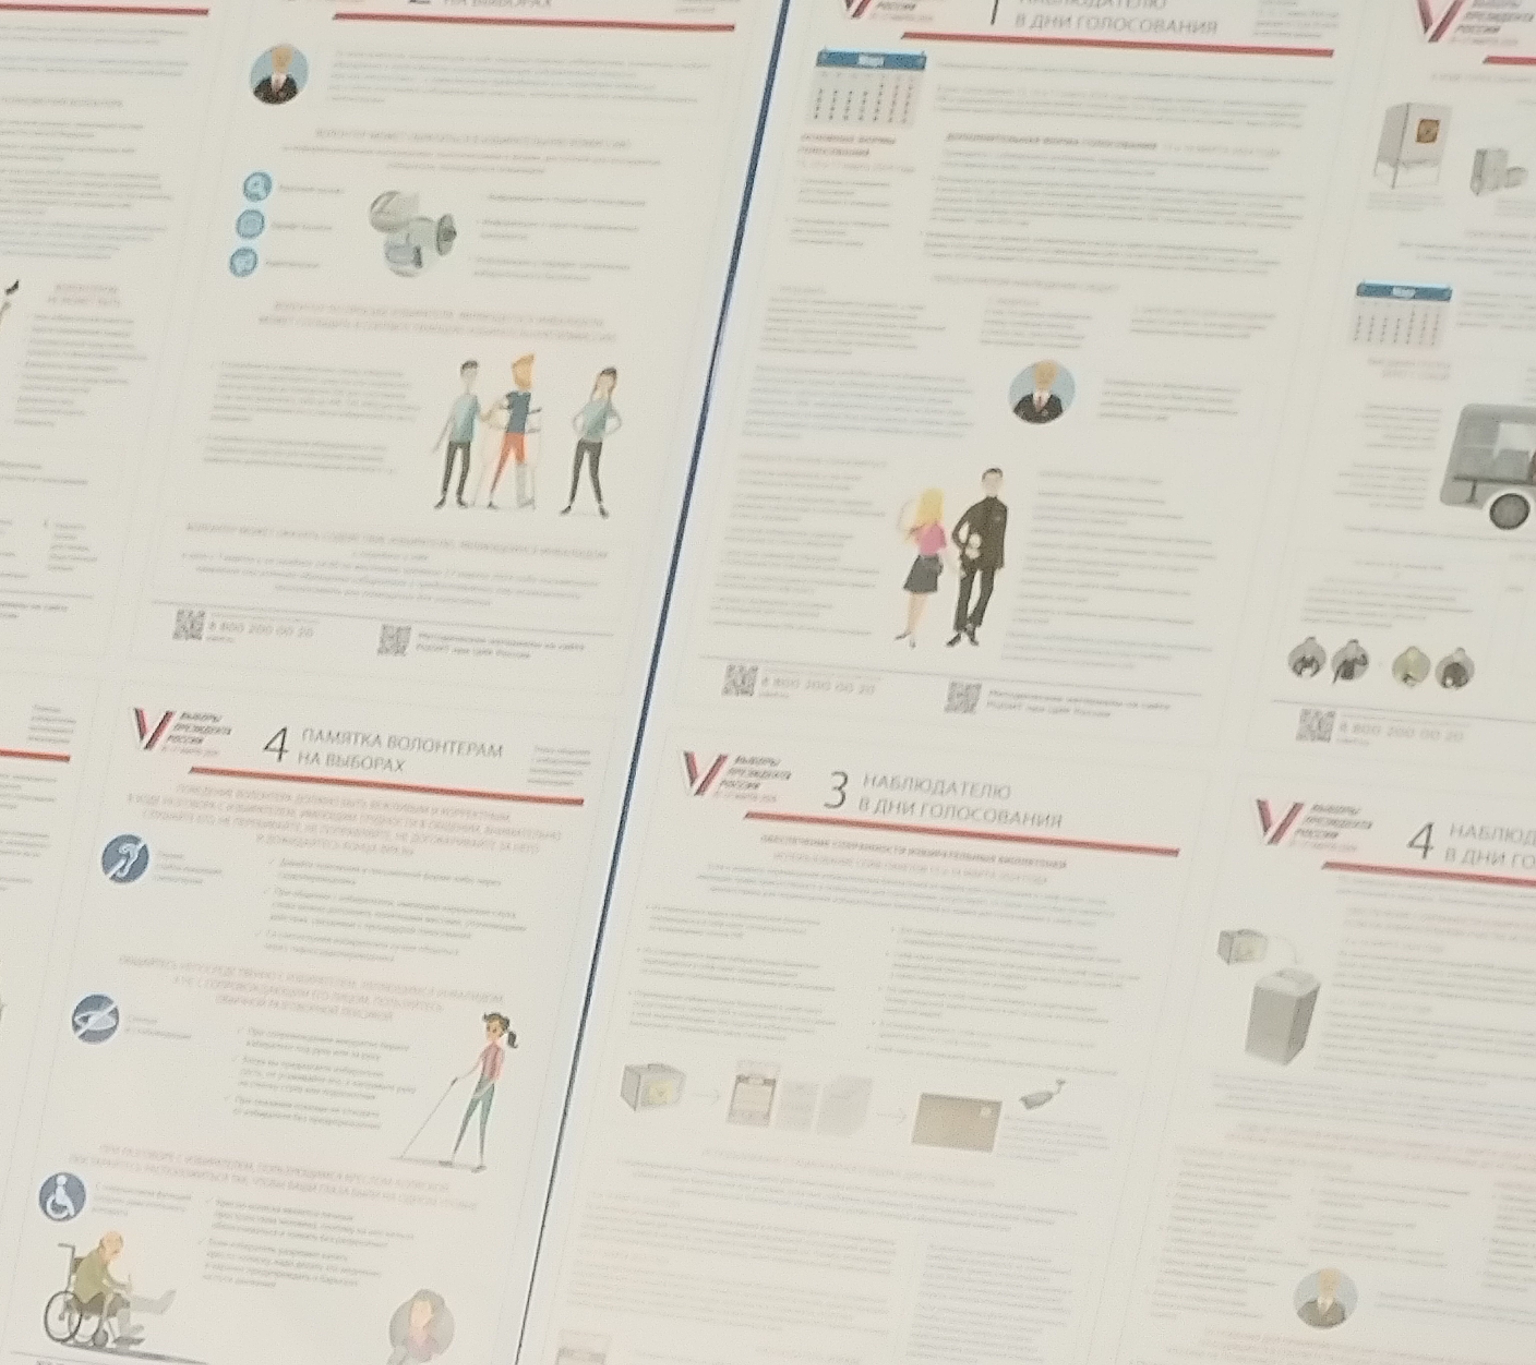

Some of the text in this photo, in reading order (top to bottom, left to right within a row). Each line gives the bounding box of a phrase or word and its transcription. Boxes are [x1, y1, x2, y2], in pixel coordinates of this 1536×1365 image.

[1029, 14, 1072, 30] ДНИ
[1076, 15, 1219, 34] ГОЛОСОВАНИЯ
[262, 726, 291, 763] 4
[301, 727, 504, 759] ПАМЯТКА ВОЛОНТЕРАМ
[297, 751, 406, 774] НА ВЫБОРАХ
[823, 771, 849, 809] 3
[863, 773, 1012, 799] НАБЛЮДАТЕЛЮ
[858, 796, 1063, 829] В ДНИ ГОЛОСОВАНИЯ
[1405, 821, 1435, 860] 4
[1444, 847, 1456, 863] В
[1460, 848, 1506, 867] ДНИ
